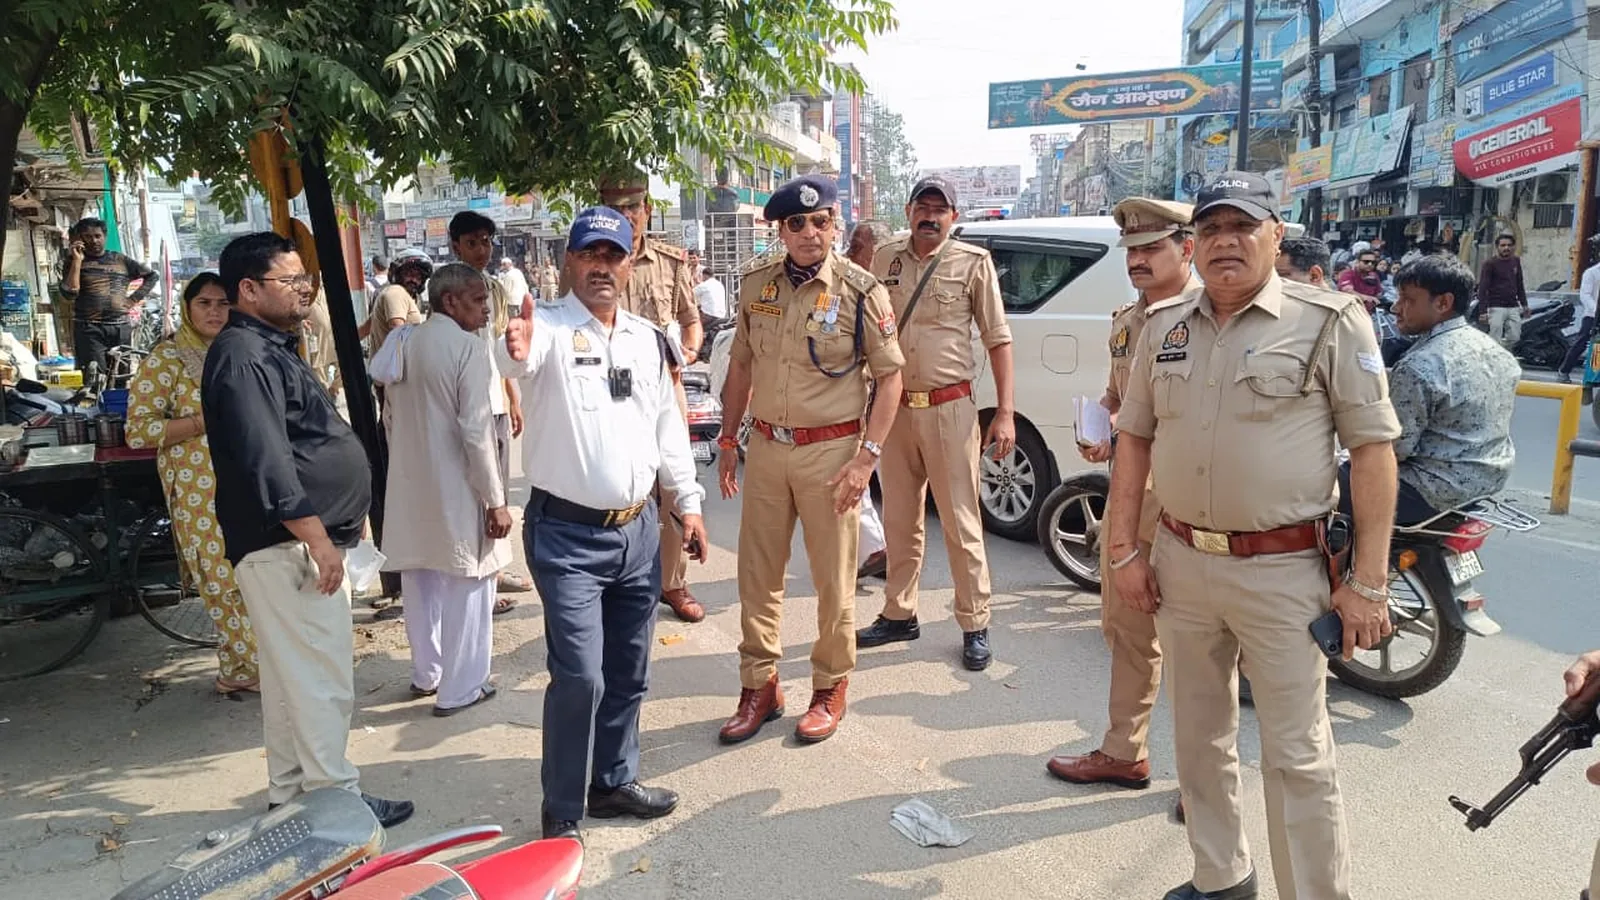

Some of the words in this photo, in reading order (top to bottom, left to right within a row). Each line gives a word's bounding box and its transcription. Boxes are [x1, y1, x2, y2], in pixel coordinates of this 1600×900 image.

[1489, 79, 1516, 101] BLUE
[1517, 65, 1547, 89] STAR
[1069, 92, 1109, 107] जैन
[1112, 88, 1188, 106] आभूषण
[1211, 179, 1250, 192] POLICE
